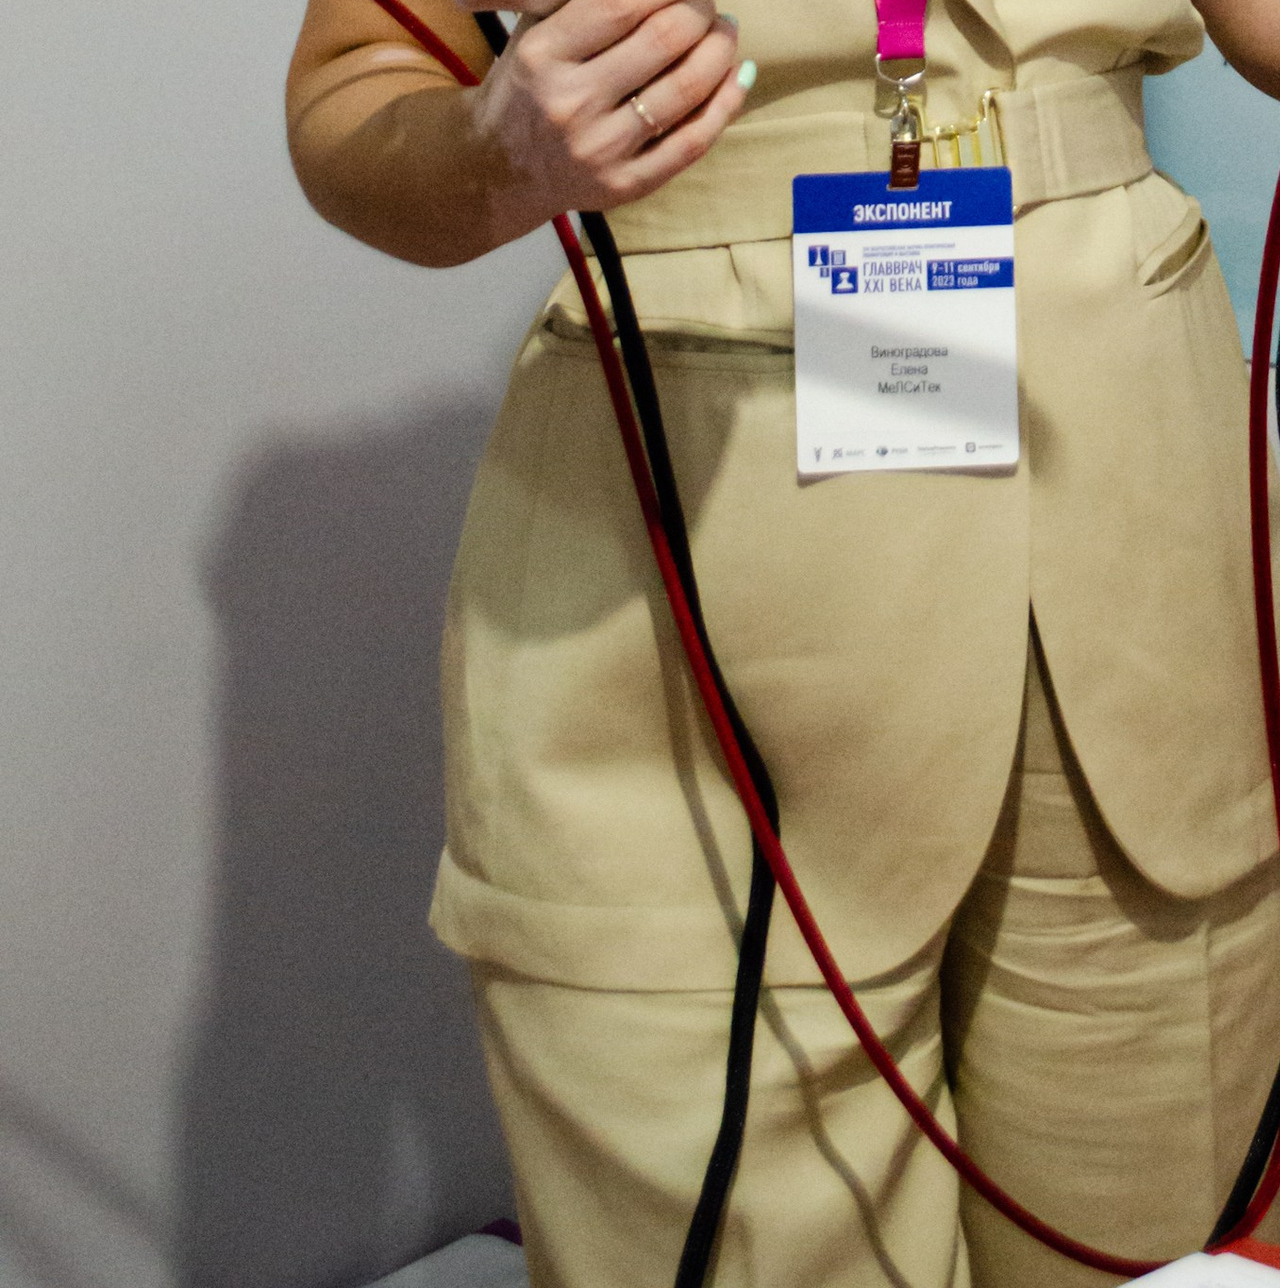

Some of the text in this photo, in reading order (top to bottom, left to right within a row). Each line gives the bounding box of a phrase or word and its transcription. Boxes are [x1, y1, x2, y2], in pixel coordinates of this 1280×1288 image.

[853, 200, 953, 223] ЭКСПОНЕНТ
[863, 260, 922, 276] ГЛАВВРАЧ
[957, 260, 1000, 274] сентября
[864, 277, 922, 293] XXI ВЕКА
[932, 275, 979, 287] 2023 года
[871, 345, 949, 360] Виноградова
[890, 363, 929, 376] Елена
